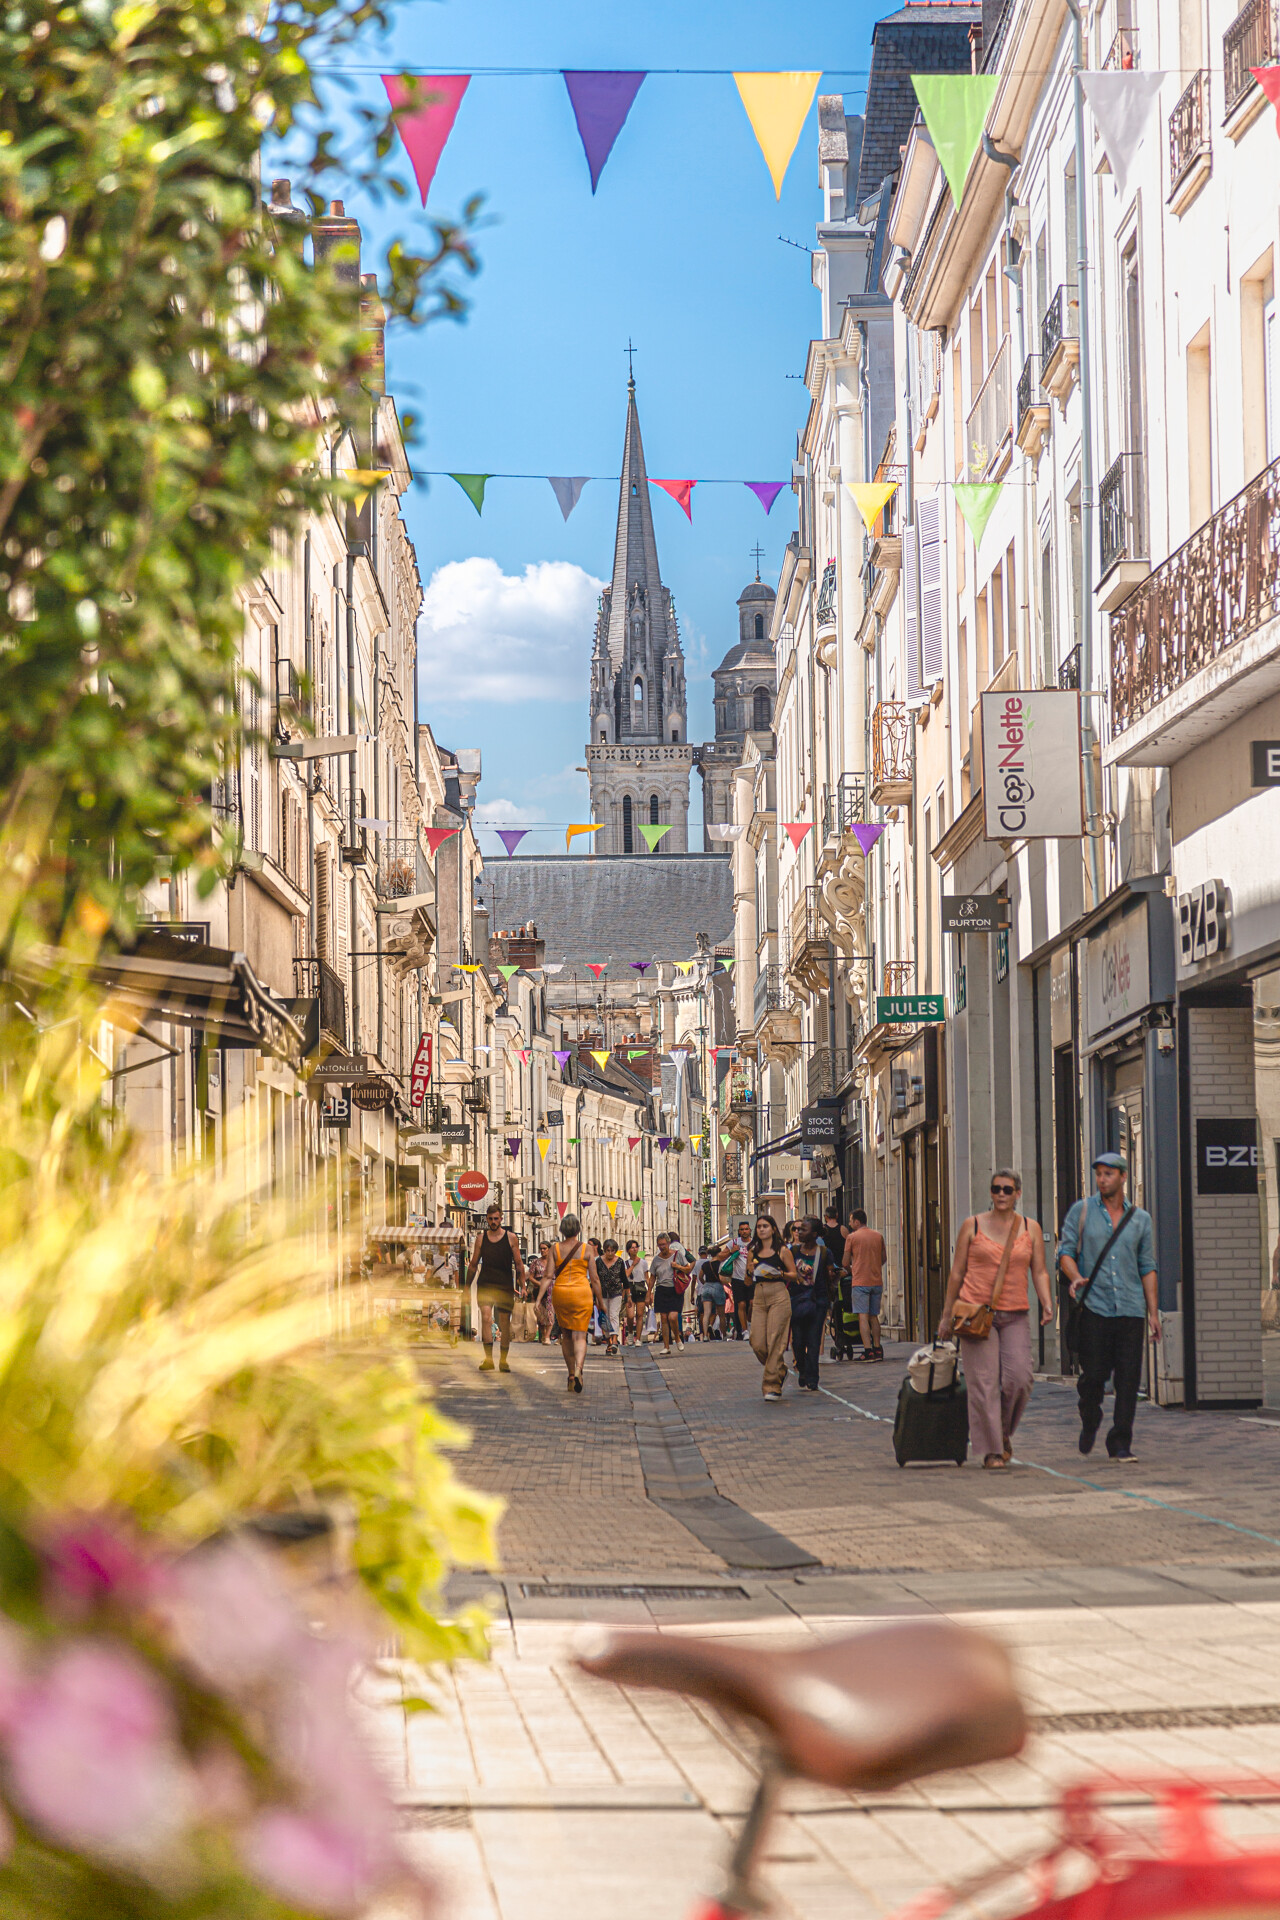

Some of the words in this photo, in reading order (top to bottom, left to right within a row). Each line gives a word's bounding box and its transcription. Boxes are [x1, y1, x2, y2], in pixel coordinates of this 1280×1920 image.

[949, 919, 991, 927] BURTON
[1179, 879, 1222, 966] BZB
[884, 1001, 938, 1016] JULES
[412, 1035, 431, 1105] TABAC
[441, 1129, 465, 1138] acadi
[807, 1127, 835, 1135] ESPACE
